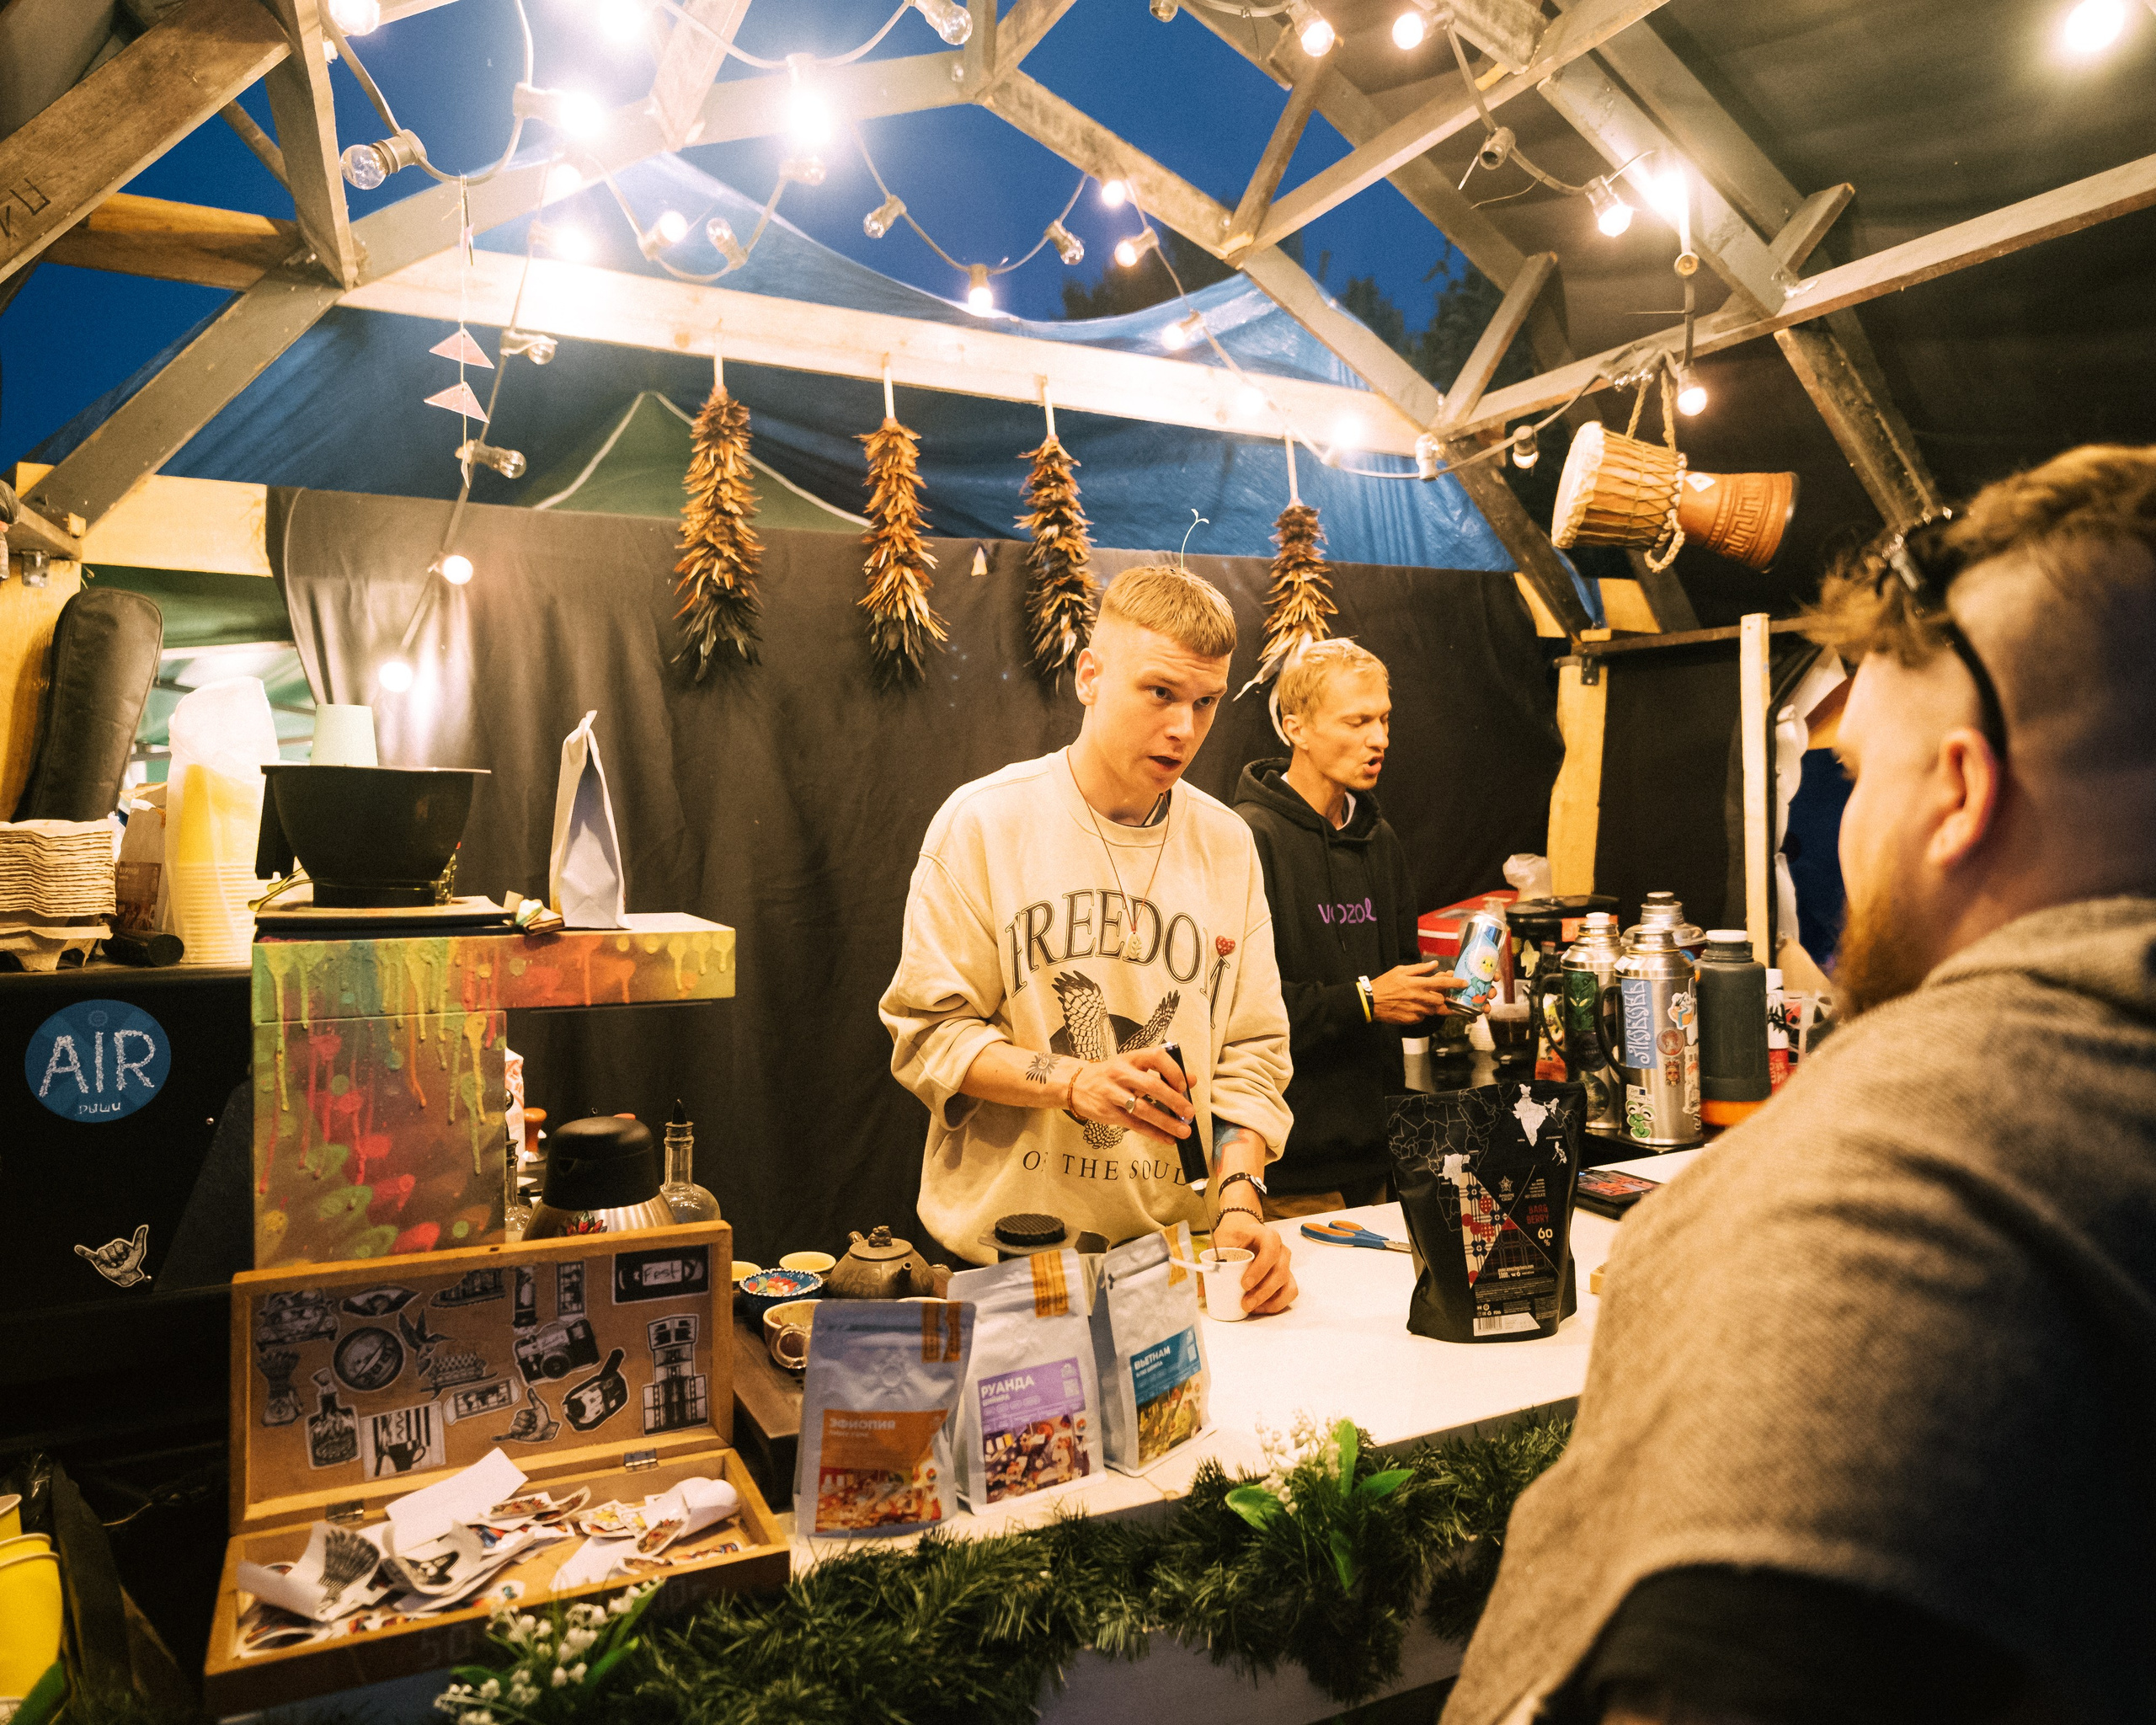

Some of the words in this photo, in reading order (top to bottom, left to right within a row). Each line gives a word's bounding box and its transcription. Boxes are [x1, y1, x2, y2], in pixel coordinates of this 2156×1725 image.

[39, 1029, 155, 1097] AIR
[1062, 1153, 1118, 1180] THE
[1526, 1214, 1549, 1224] BERRY
[1537, 1227, 1553, 1239] 60
[1134, 1345, 1171, 1370] ВЬЕТНАМ
[980, 1375, 1035, 1398] РУАНДА
[829, 1418, 896, 1430] ЭФИОПИЯ
